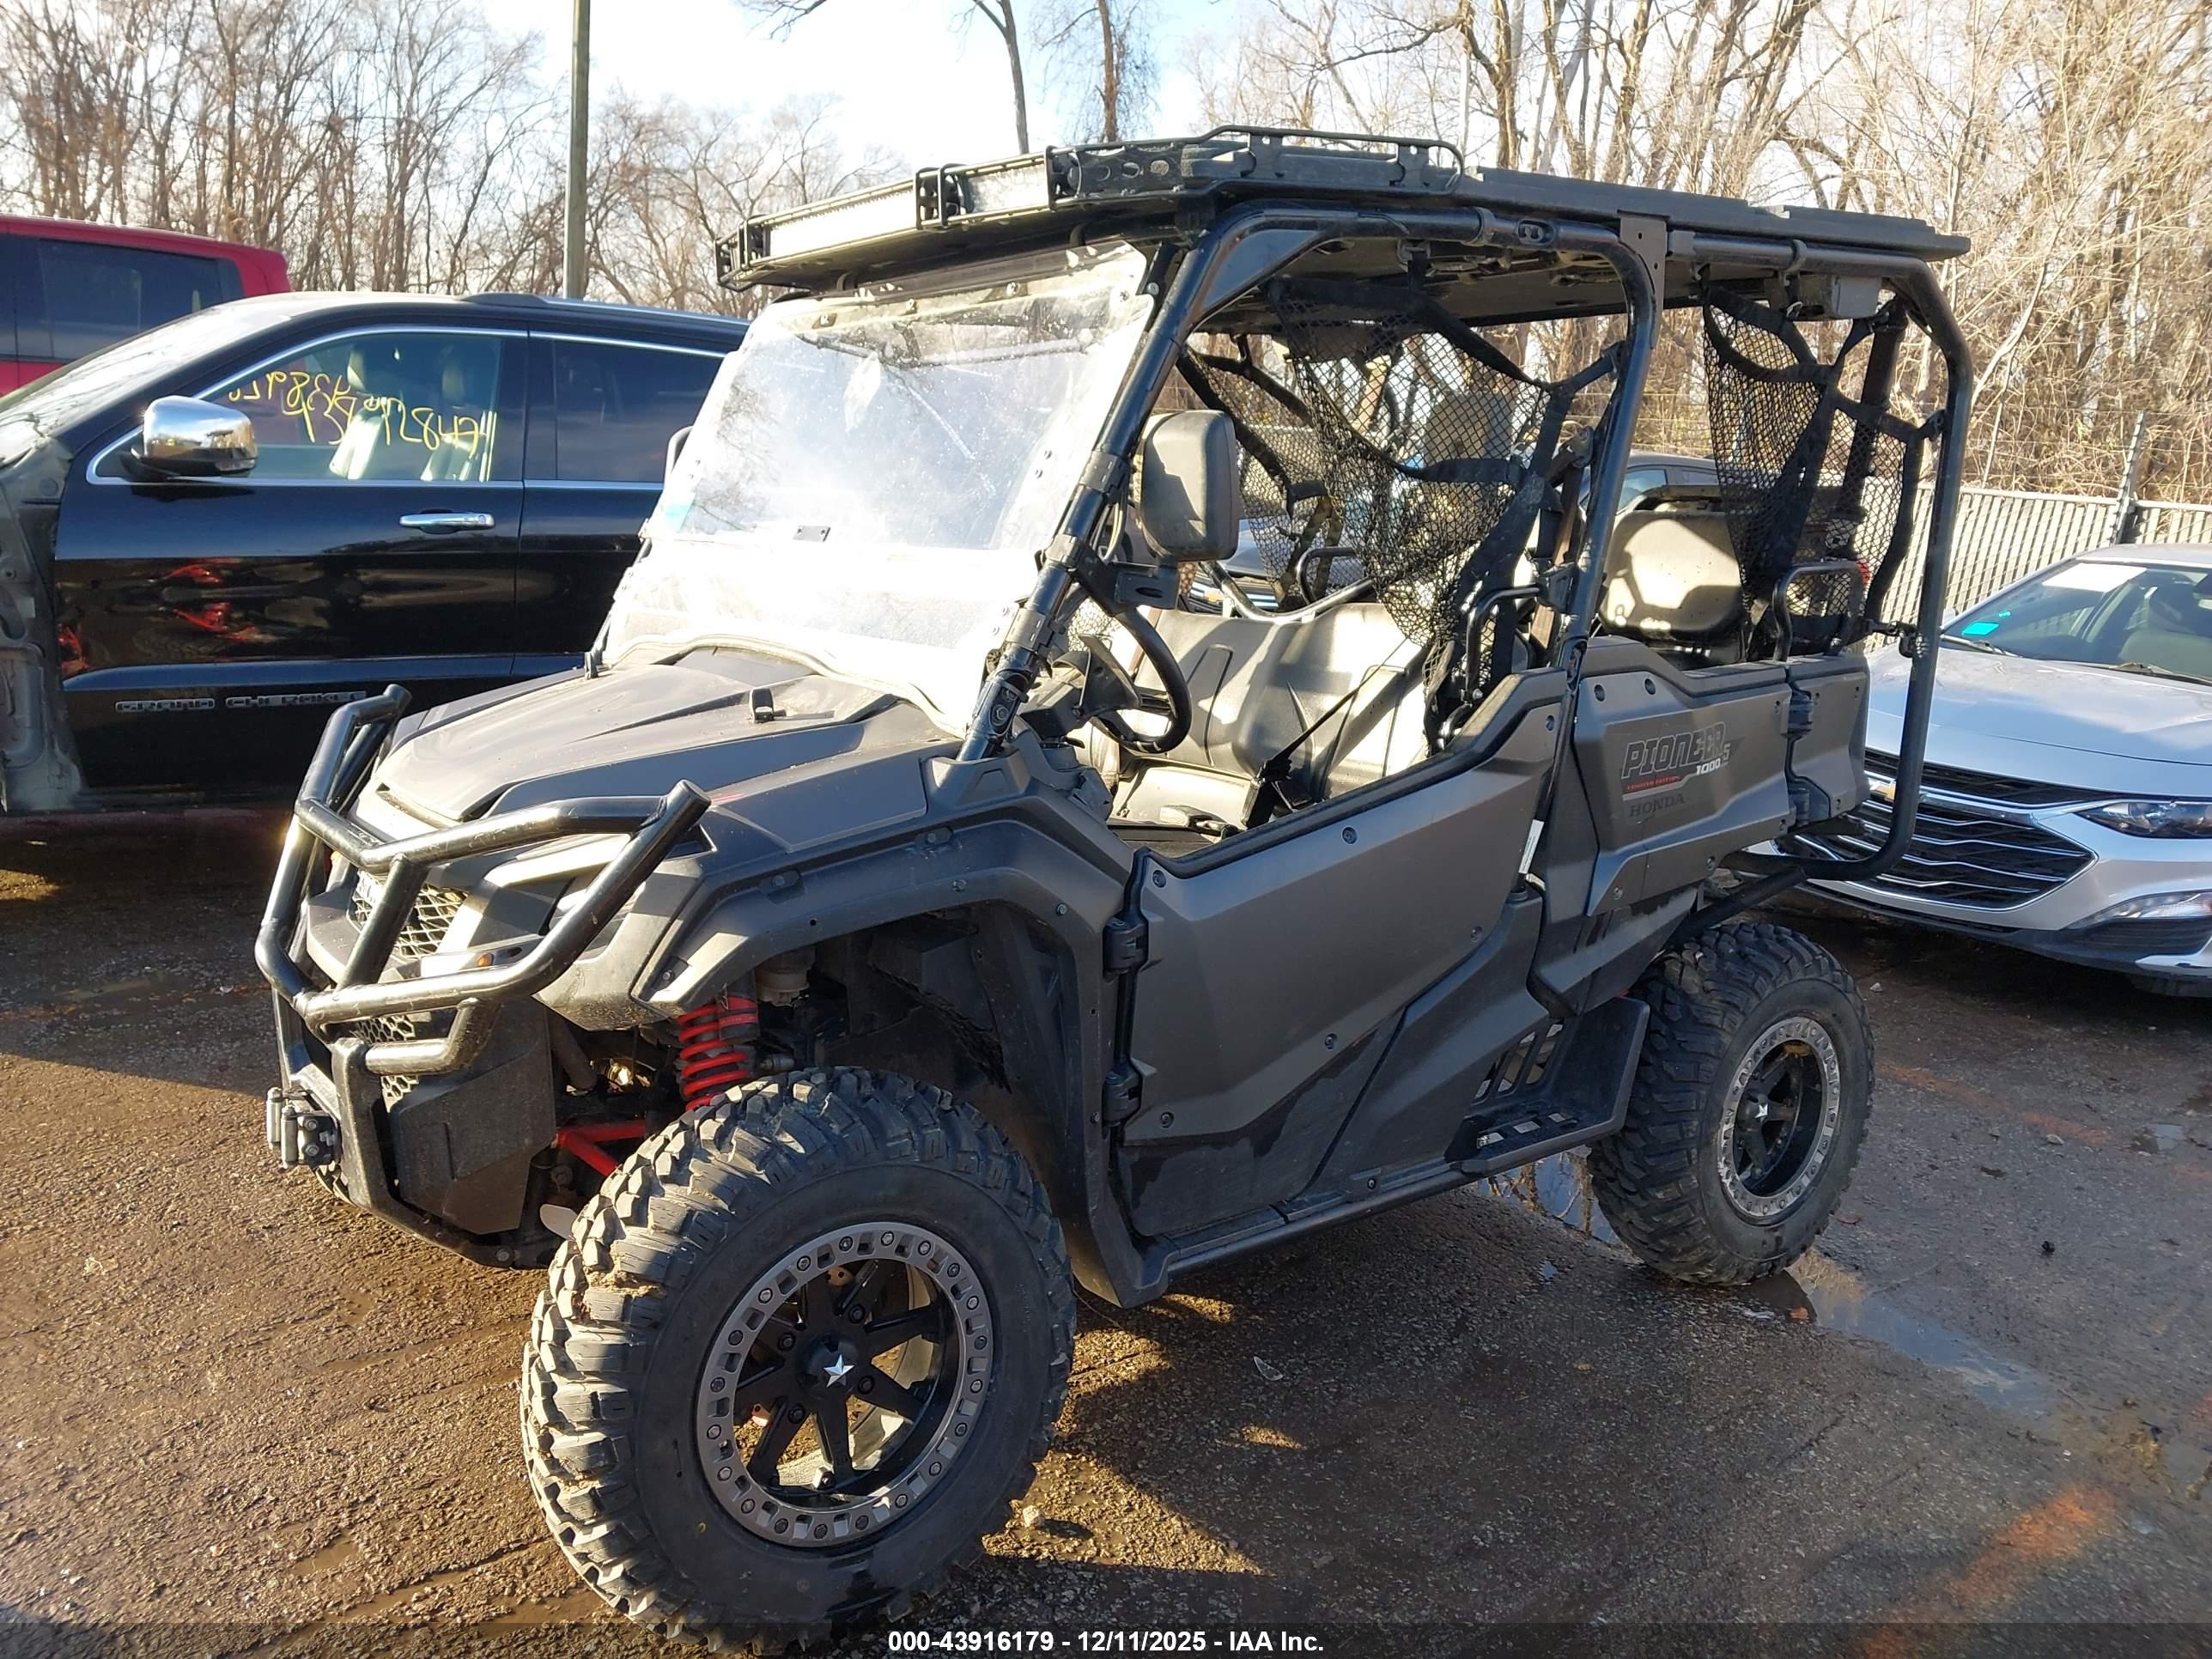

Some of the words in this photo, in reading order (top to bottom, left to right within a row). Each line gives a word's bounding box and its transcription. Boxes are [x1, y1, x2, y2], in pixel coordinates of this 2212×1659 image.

[115, 698, 215, 713] GRAND
[225, 690, 367, 708] CHEROKEE
[1621, 721, 1726, 779] PIONEER
[1630, 793, 1686, 817] HONDA
